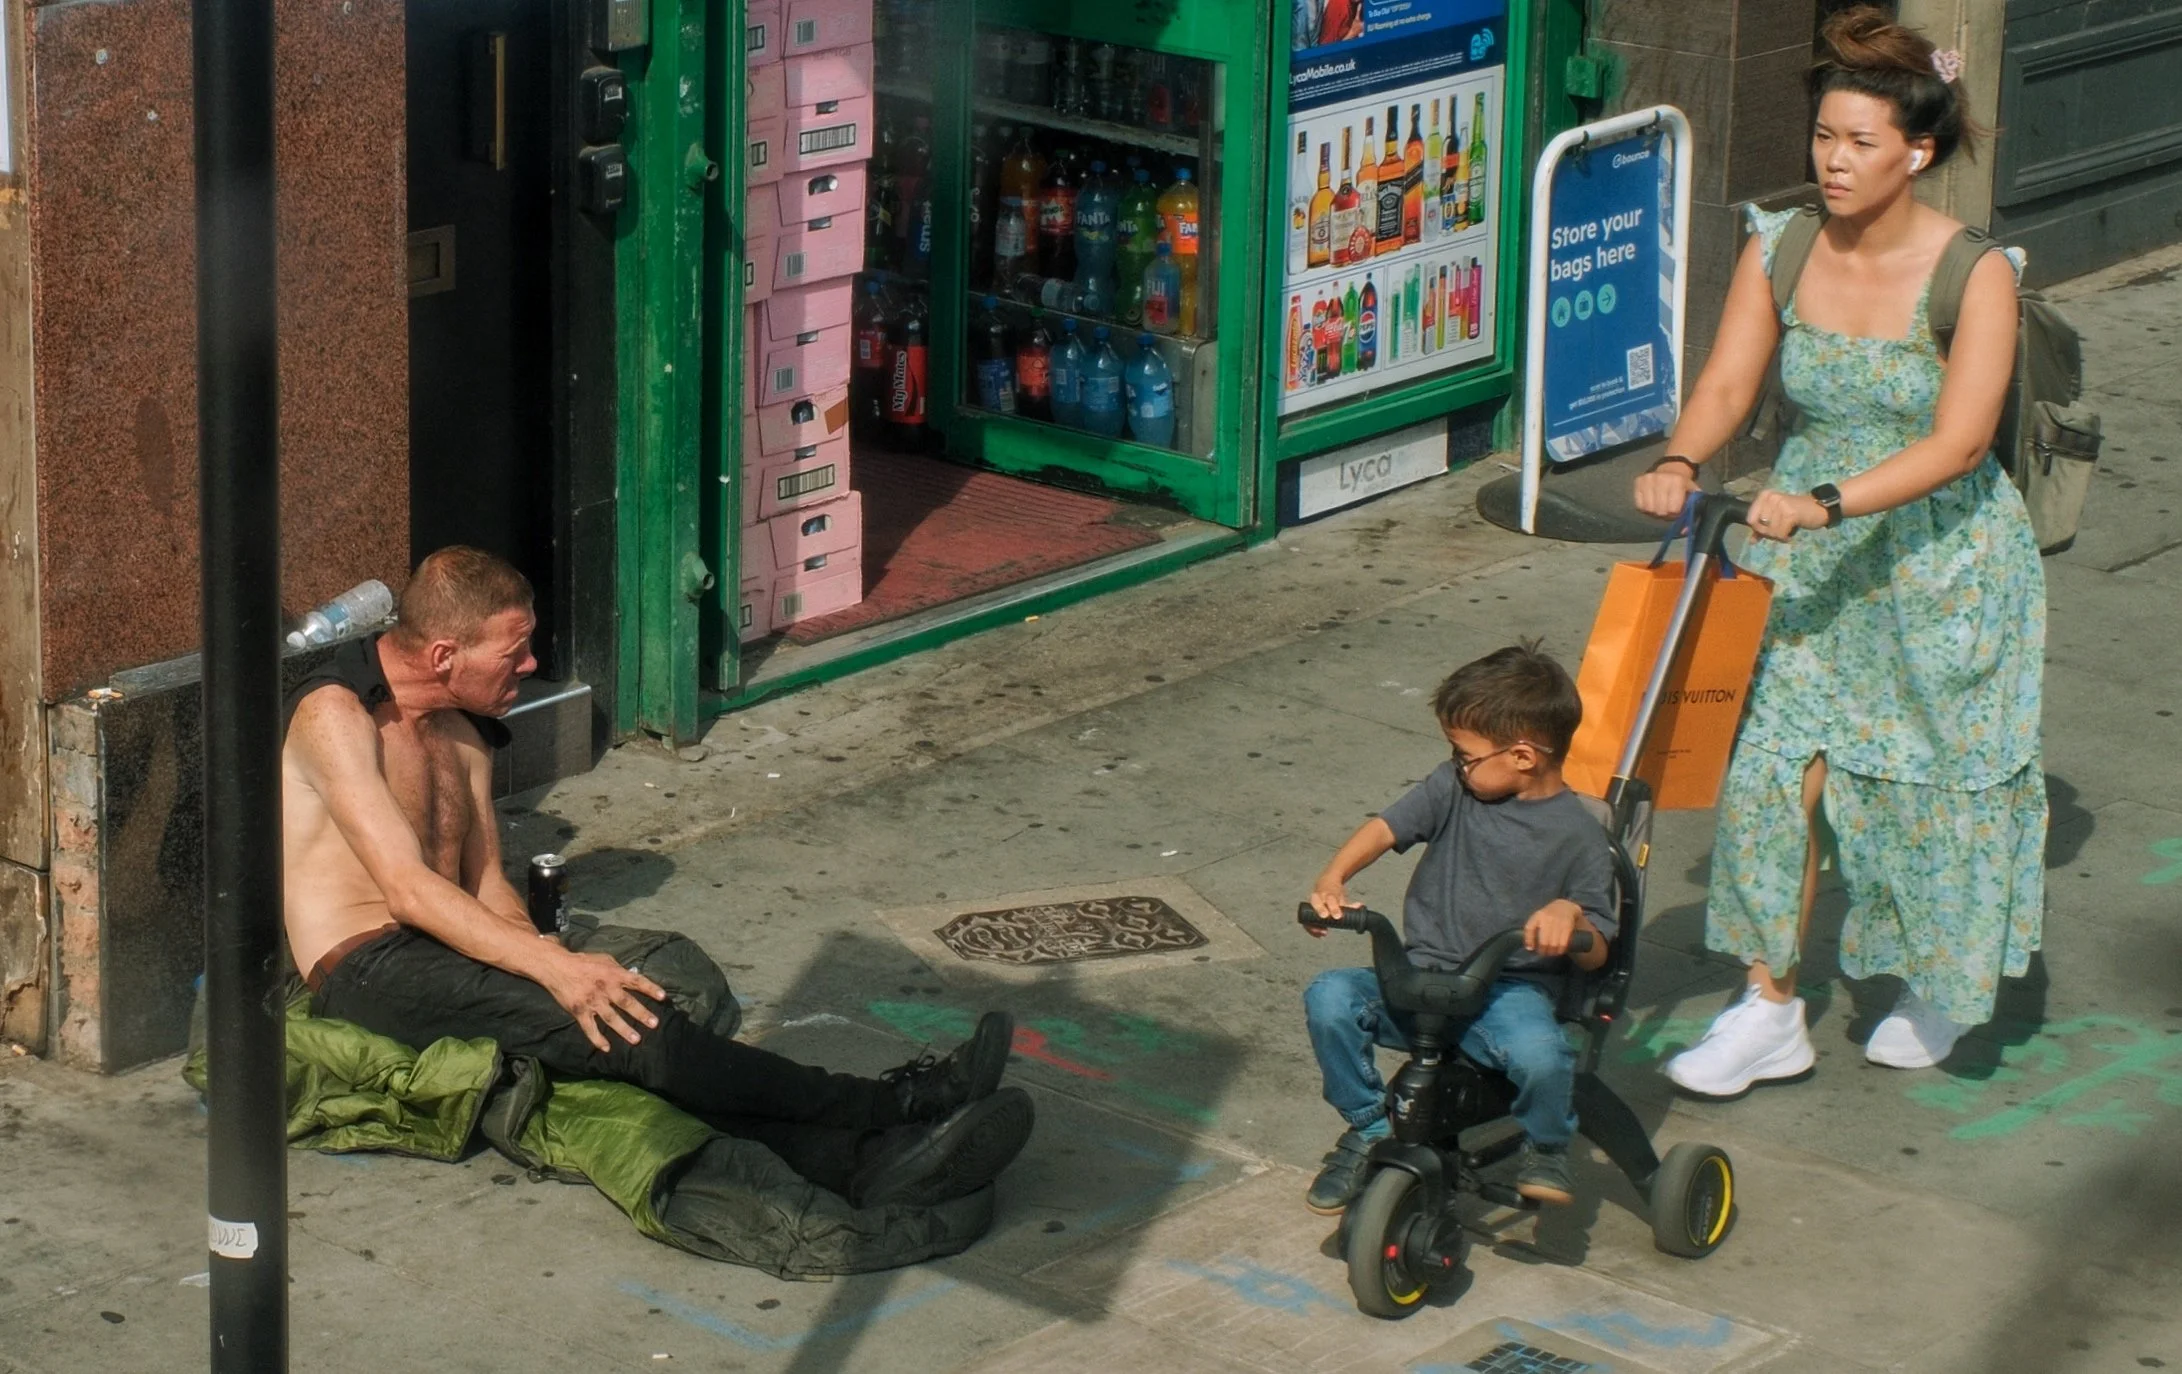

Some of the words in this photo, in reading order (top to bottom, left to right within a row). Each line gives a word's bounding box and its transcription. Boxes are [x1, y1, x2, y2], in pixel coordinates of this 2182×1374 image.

[1076, 209, 1111, 227] FANTA
[1551, 219, 1597, 250] Store
[1602, 208, 1644, 241] your
[1550, 253, 1592, 283] bags
[1597, 242, 1636, 270] here
[892, 350, 907, 389] Mates
[892, 389, 908, 412] My
[1340, 453, 1391, 492] Lyca
[1683, 689, 1736, 704] VUITTON
